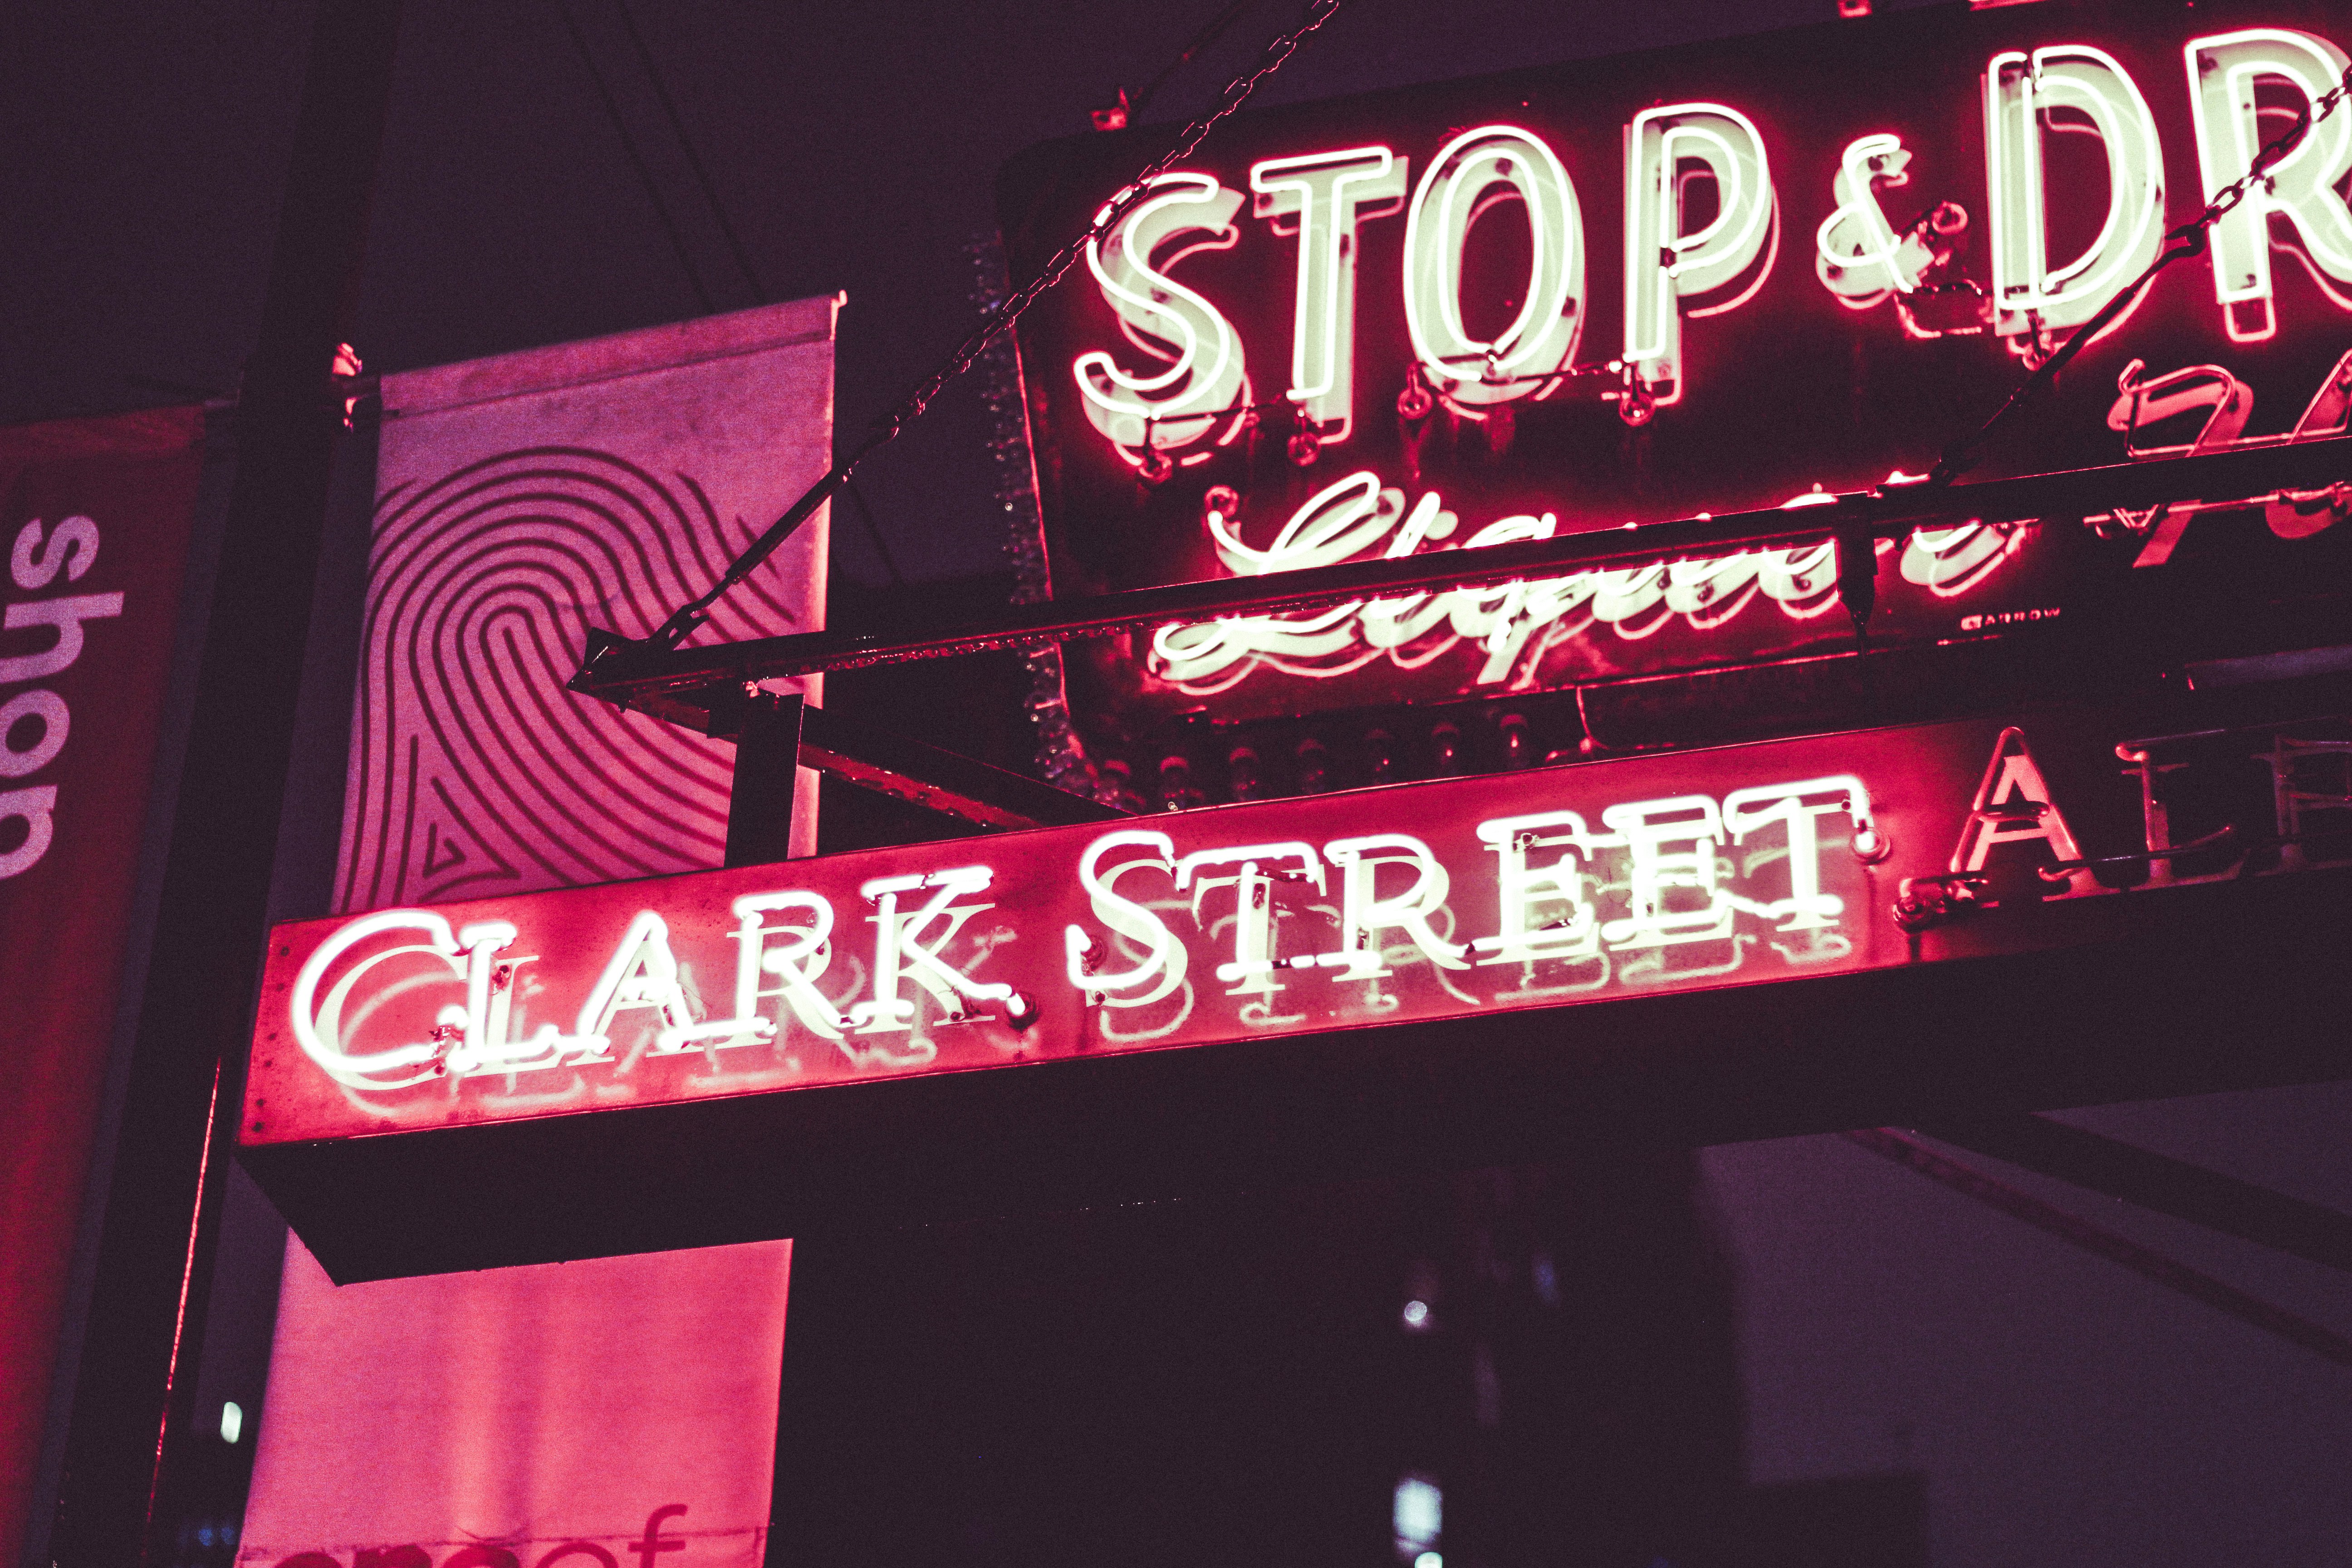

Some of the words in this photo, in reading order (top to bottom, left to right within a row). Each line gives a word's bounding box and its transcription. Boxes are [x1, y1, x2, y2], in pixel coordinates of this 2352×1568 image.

[1073, 102, 1779, 456] STOP
[1816, 133, 1935, 309] &
[1982, 28, 2352, 343] DR
[289, 864, 1038, 1107] CLARK
[1066, 775, 1893, 1034] STREET
